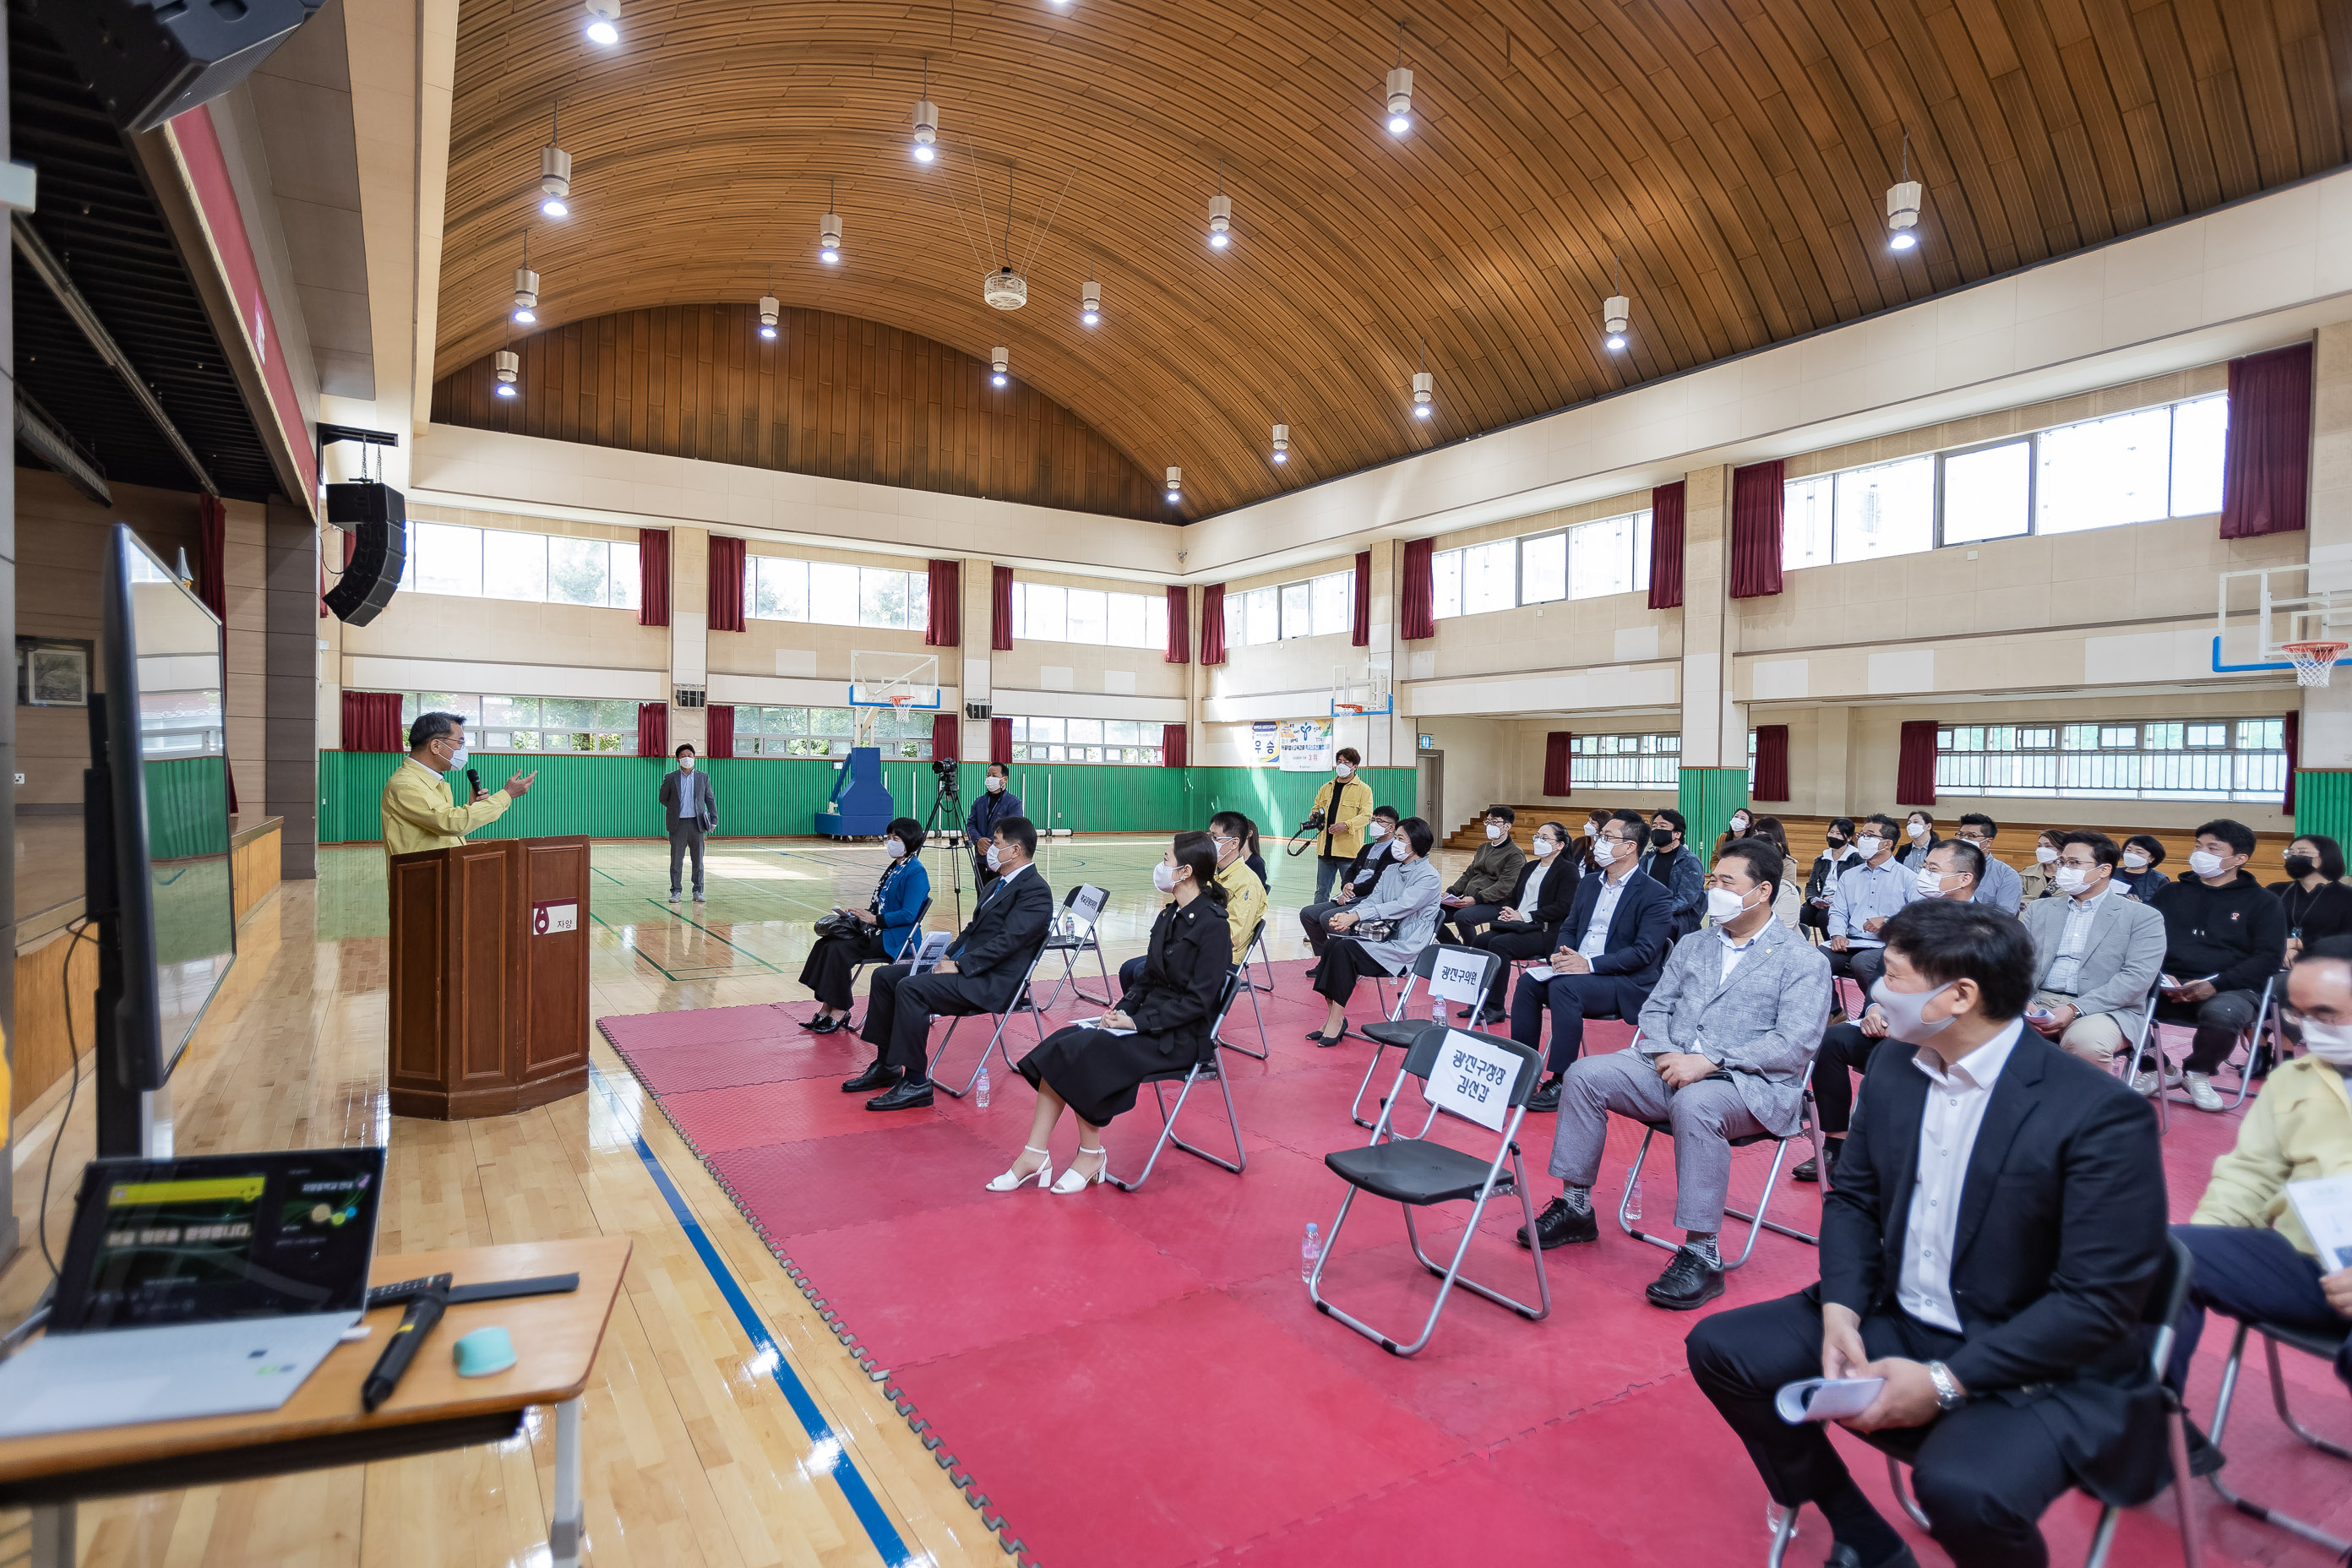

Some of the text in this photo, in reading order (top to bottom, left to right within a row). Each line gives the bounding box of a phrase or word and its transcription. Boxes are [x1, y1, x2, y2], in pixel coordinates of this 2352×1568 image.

[557, 919, 573, 929] 자양
[1441, 966, 1478, 986] 광진구의원
[1453, 1049, 1506, 1086] 광진구청장
[1456, 1075, 1490, 1103] 김선갑
